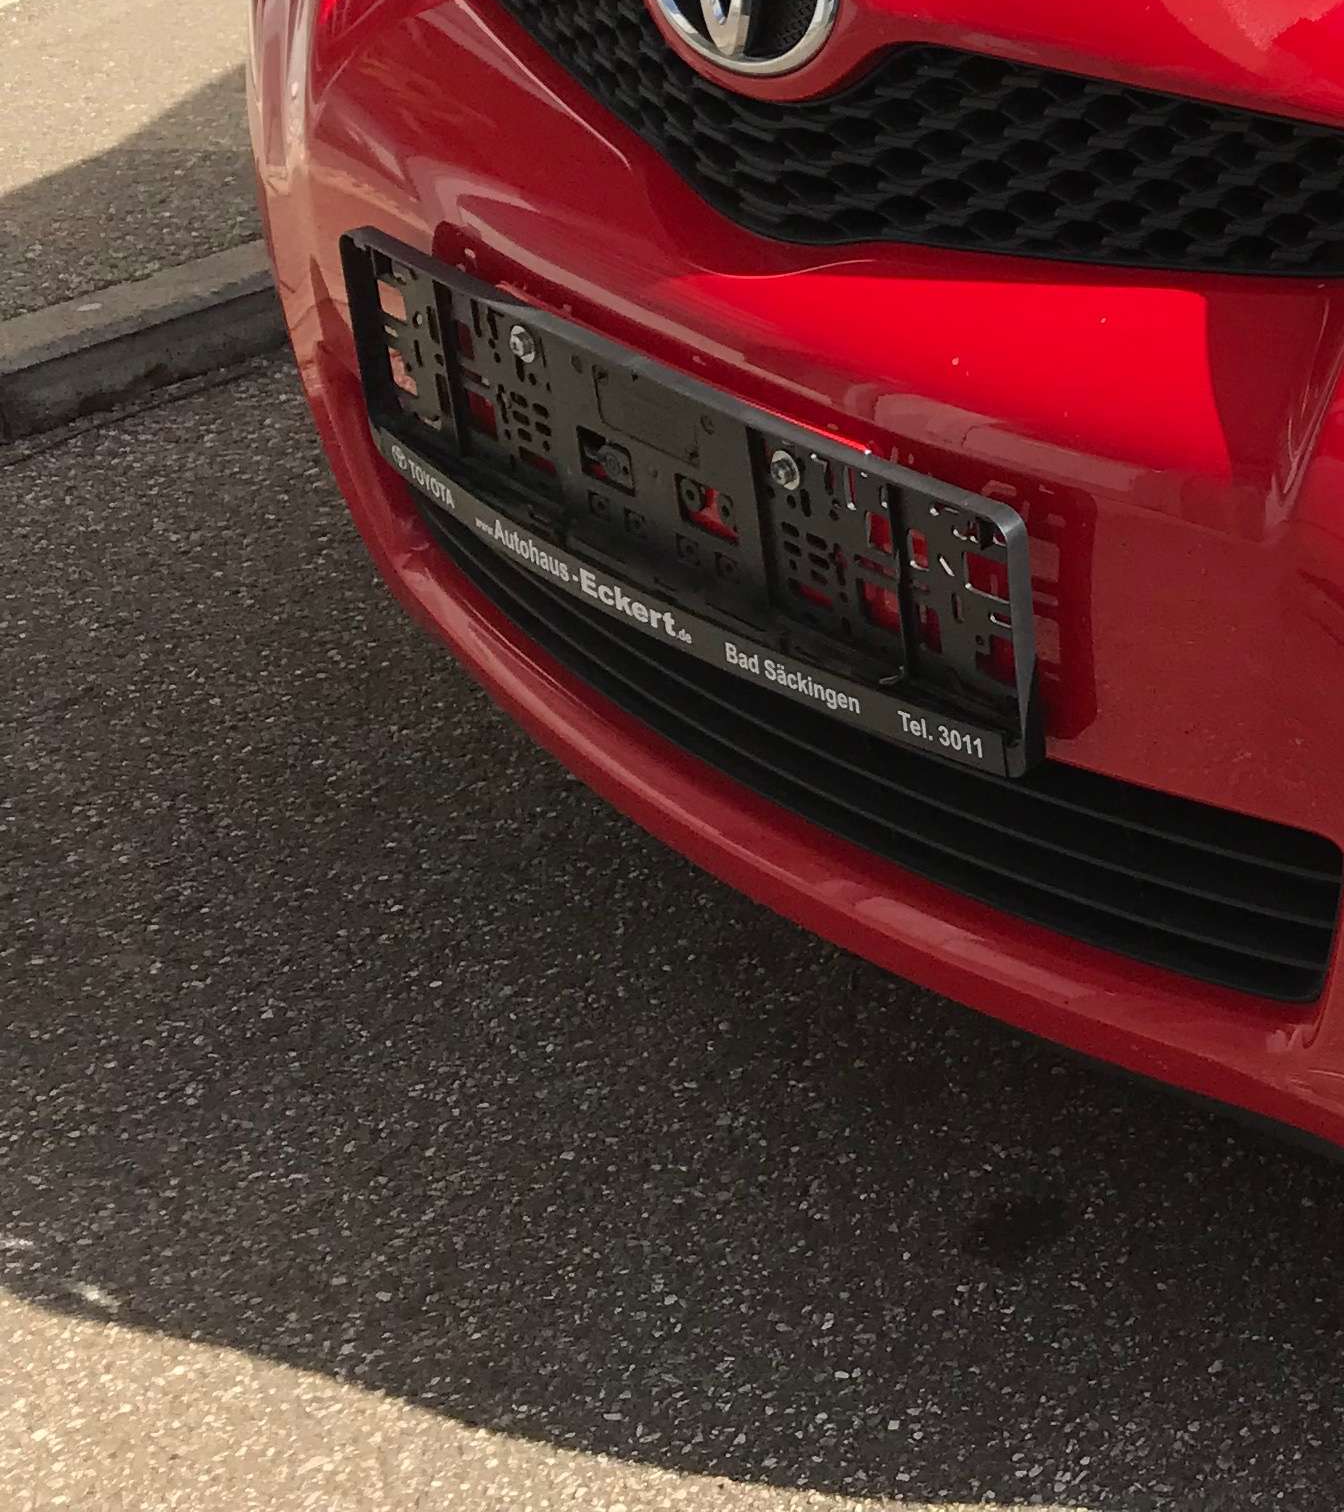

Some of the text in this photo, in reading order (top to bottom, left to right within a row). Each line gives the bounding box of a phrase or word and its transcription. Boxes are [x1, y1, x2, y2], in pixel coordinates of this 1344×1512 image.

[407, 461, 456, 509] TOYOTA
[724, 641, 760, 675] Bad
[764, 658, 861, 714] Säckingen
[897, 710, 934, 741] Tel.
[937, 724, 984, 759] 3011
